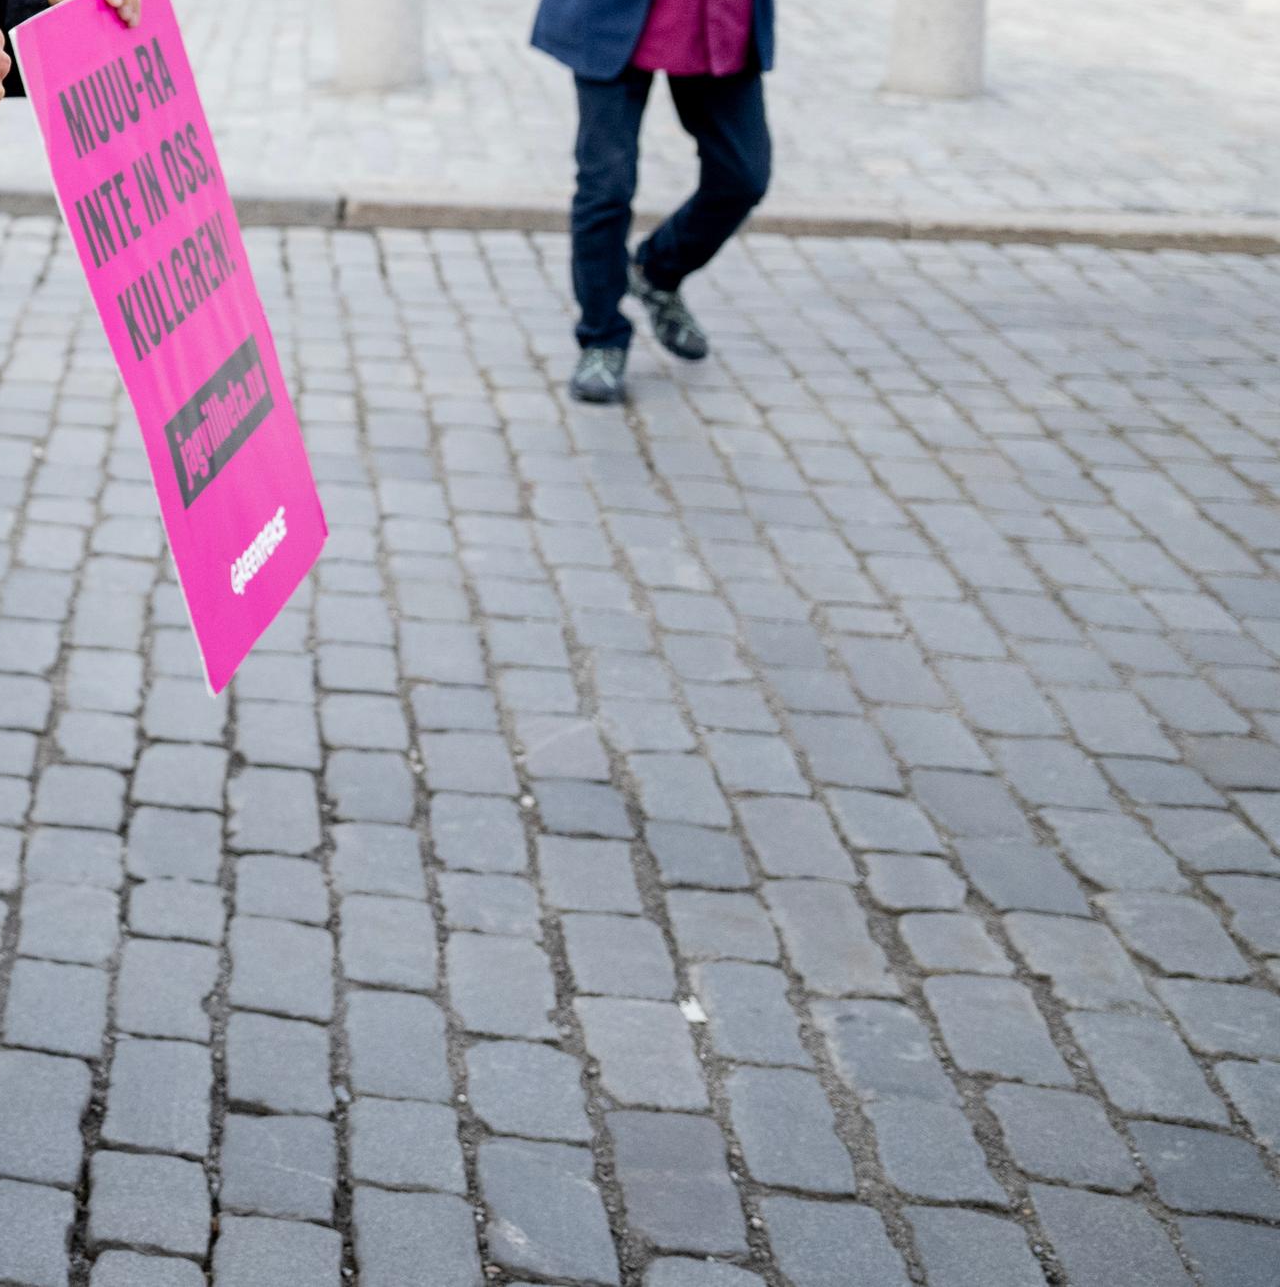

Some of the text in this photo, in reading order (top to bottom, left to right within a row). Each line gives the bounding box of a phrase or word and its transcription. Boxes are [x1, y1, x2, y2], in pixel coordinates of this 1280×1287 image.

[58, 37, 177, 159] MUUU-RA
[75, 121, 217, 269] INTE IN OSS,
[117, 209, 237, 362] KULLGREN!
